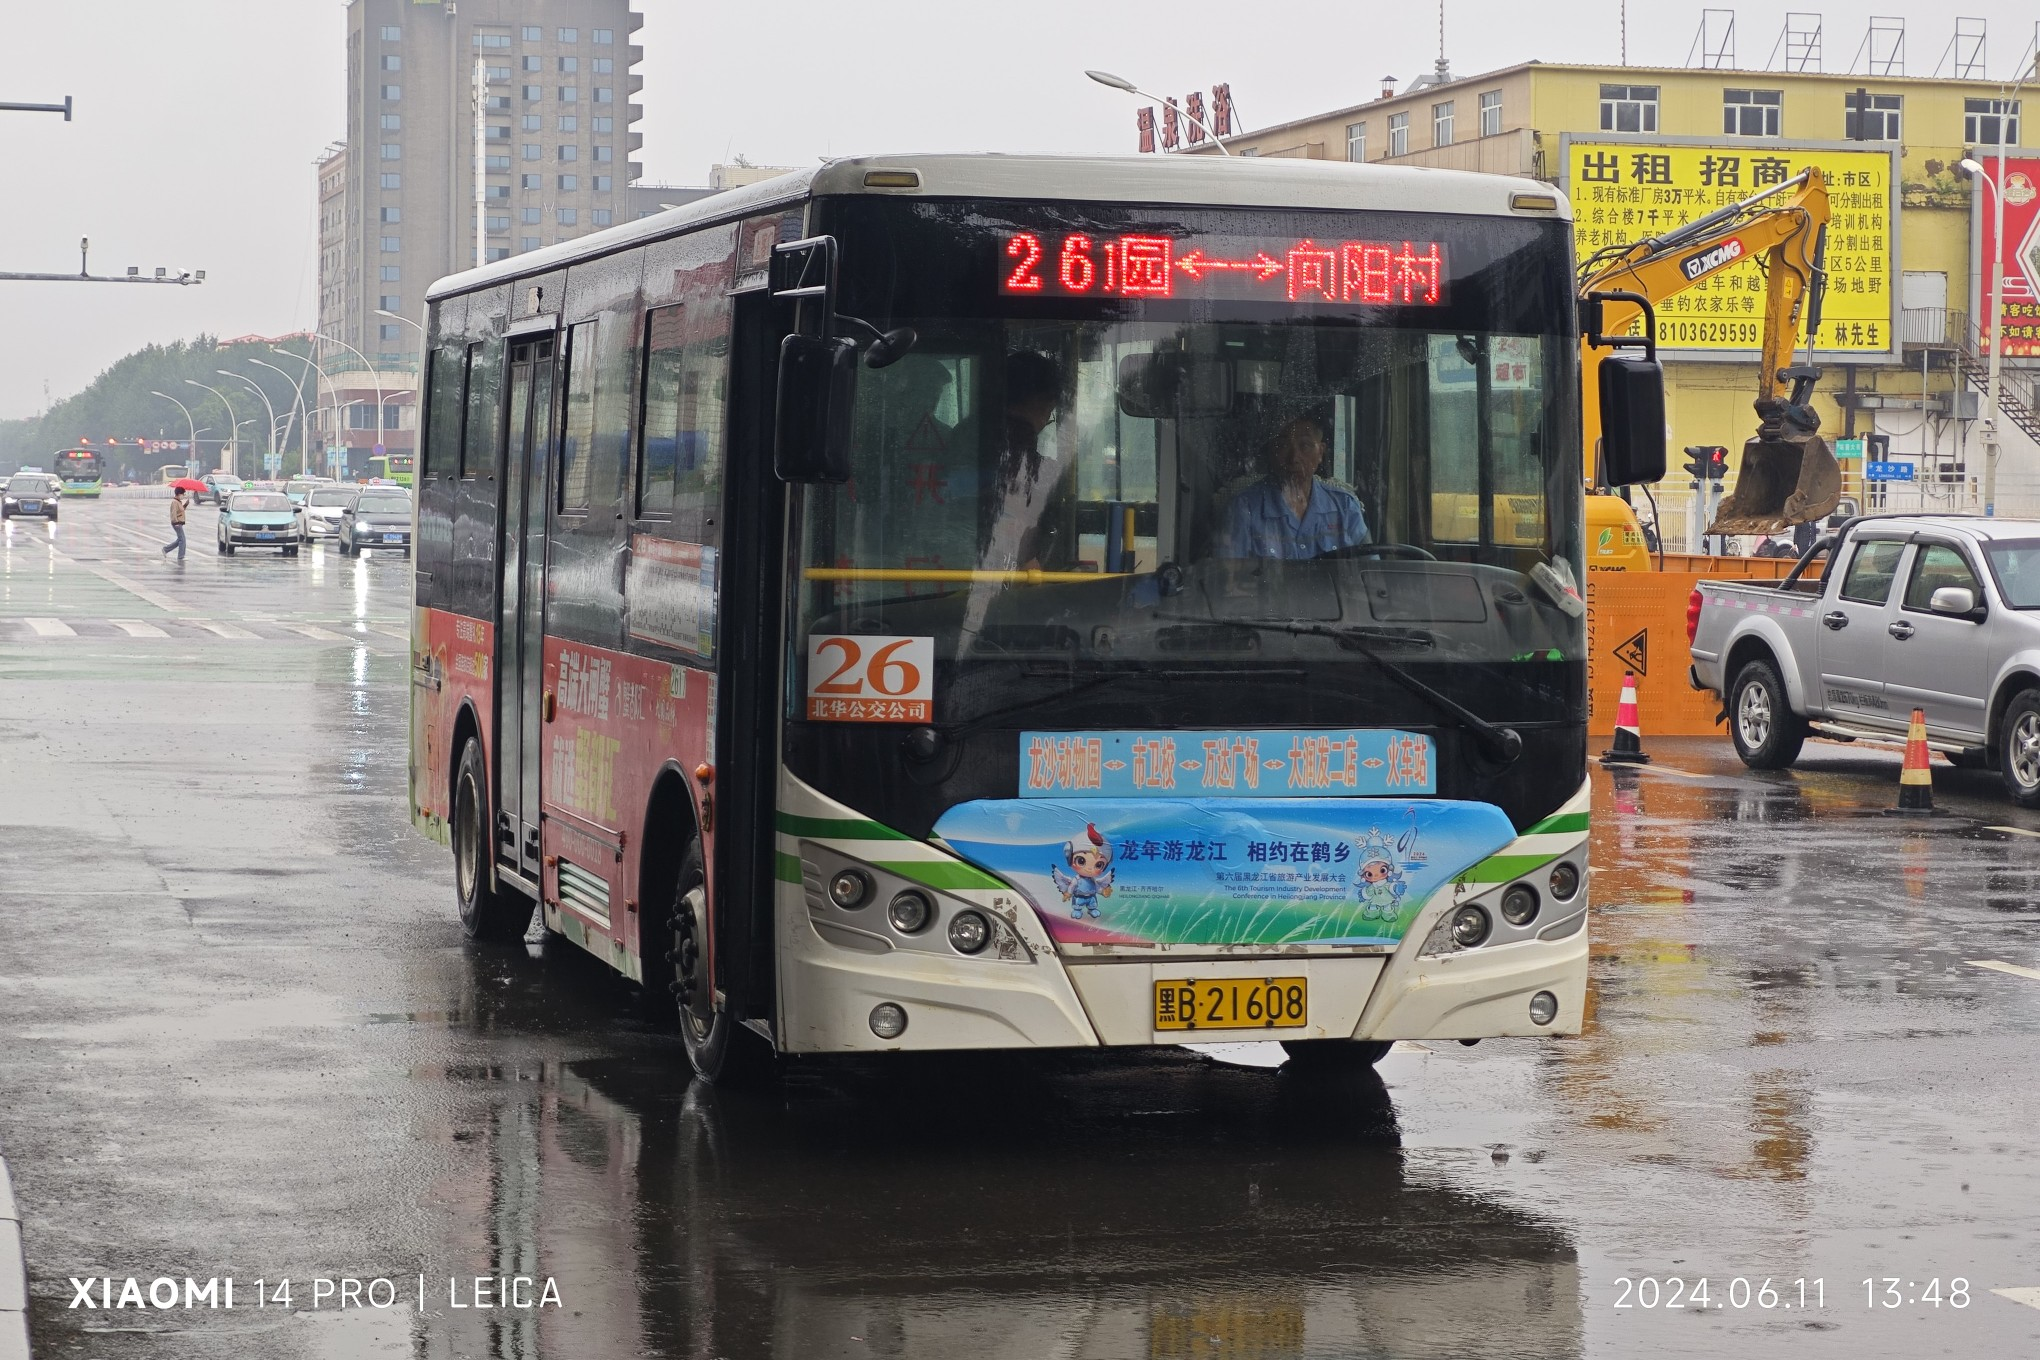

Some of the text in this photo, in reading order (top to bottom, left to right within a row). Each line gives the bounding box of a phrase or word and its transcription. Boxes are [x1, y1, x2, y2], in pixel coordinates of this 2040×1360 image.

[1582, 151, 1791, 187] 出租 招商
[1700, 240, 1741, 272] XCMG
[1286, 239, 1441, 302] 向阳村
[1660, 294, 1755, 314] 垂钓农家乐等
[1835, 322, 1880, 346] 林先生
[813, 637, 921, 696] 26
[556, 648, 611, 721] 高端大闸蟹
[812, 700, 925, 720] 北华公交公司
[1028, 735, 1428, 790] 龙沙动物园 市卫校 万达广场 大润发二店 火车站
[1118, 839, 1351, 863] 龙年游龙江 相约在鹤乡
[1216, 871, 1346, 882] 第六届黑龙江省旅游产业发展大会
[1276, 885, 1303, 894] Industry
[1304, 885, 1346, 894] Development
[1279, 893, 1318, 901] Heilongjiang
